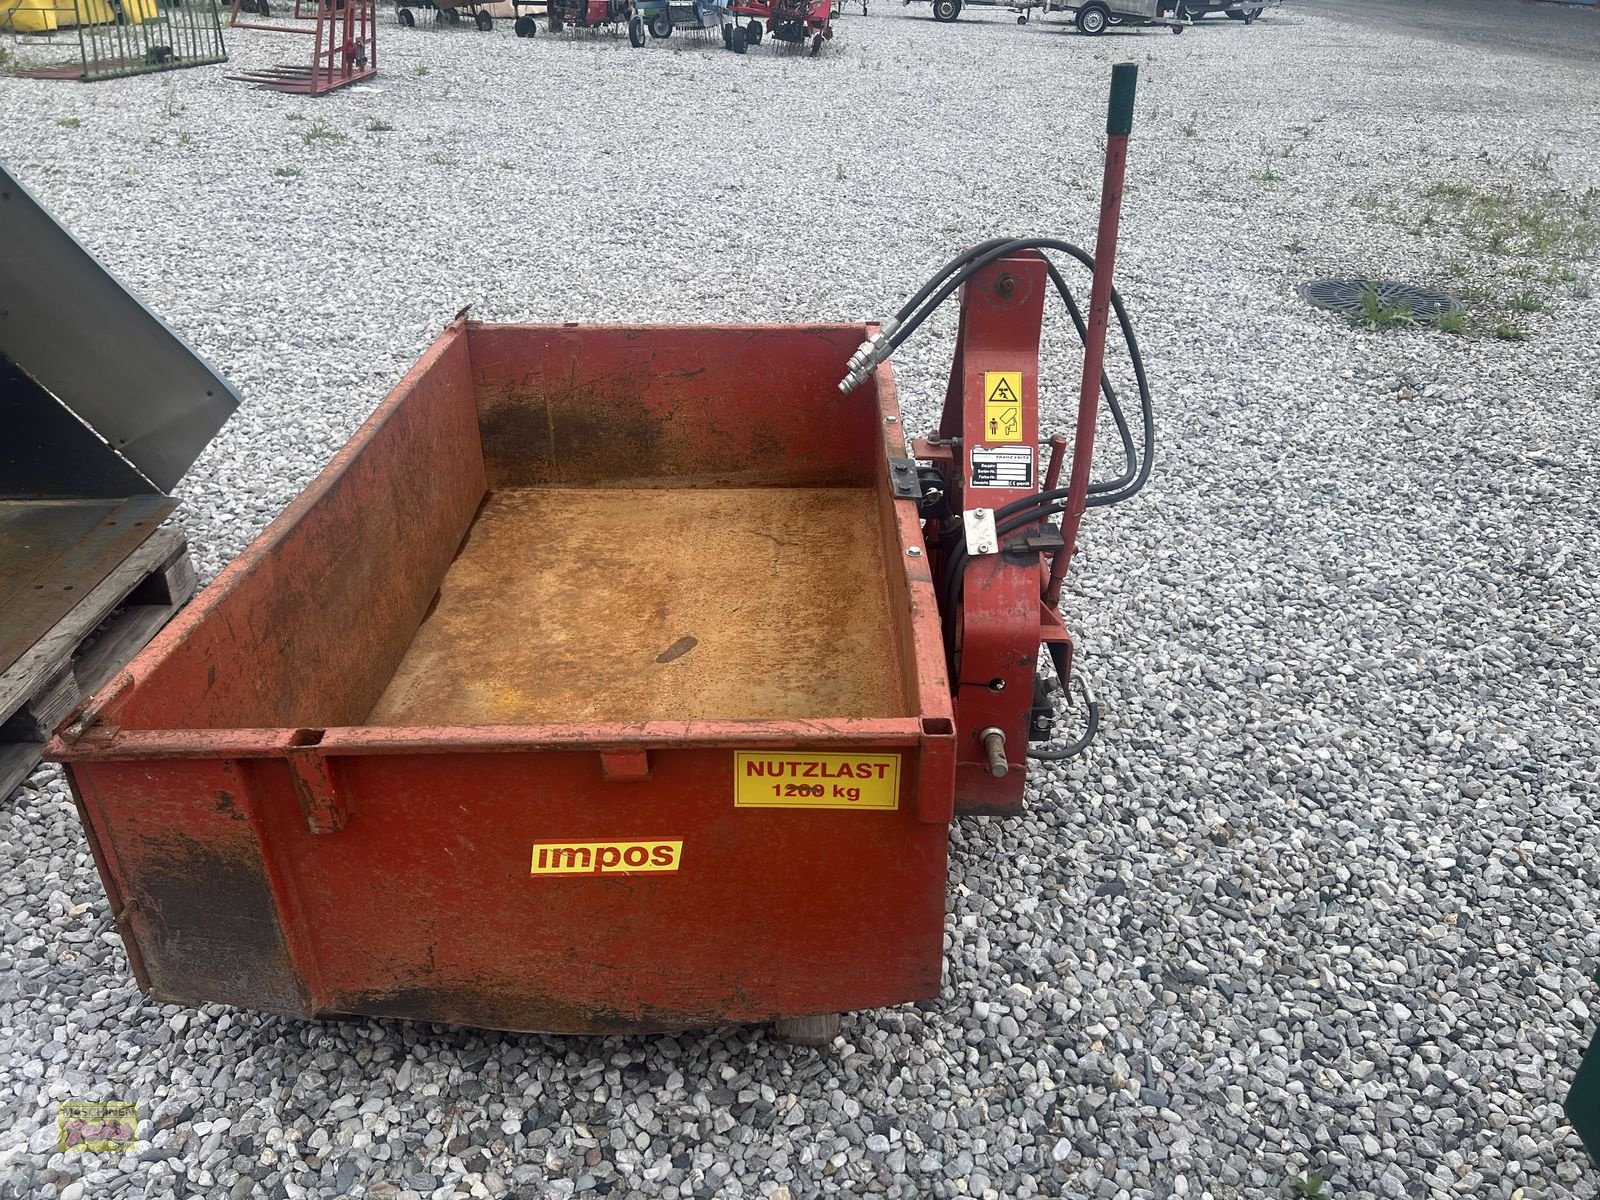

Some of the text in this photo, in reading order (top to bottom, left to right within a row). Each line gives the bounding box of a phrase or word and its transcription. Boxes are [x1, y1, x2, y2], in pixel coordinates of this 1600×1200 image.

[747, 760, 891, 778] NUTZLAST
[771, 783, 861, 802] 1200 kg
[537, 844, 674, 873] impos
